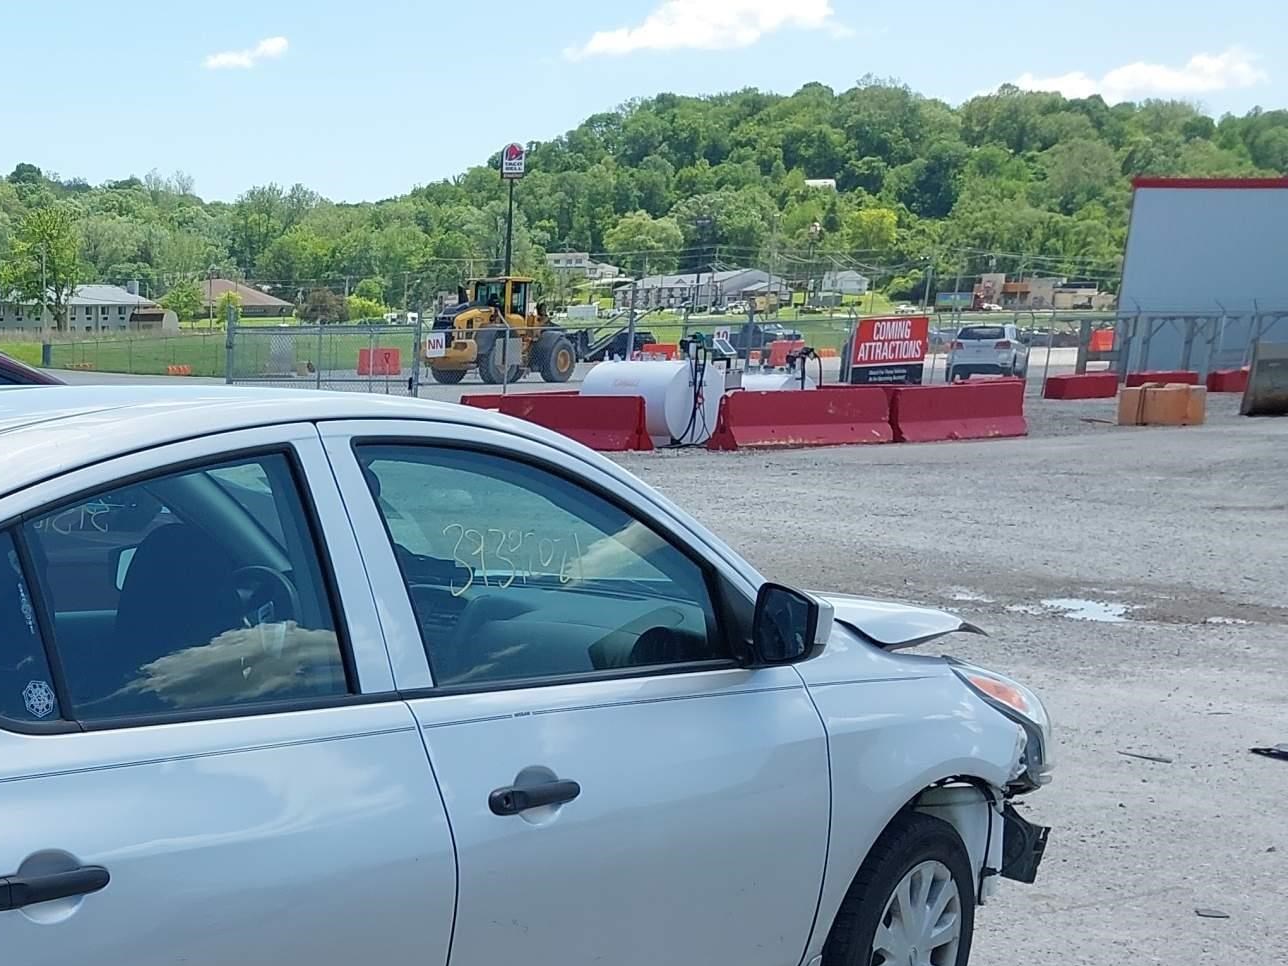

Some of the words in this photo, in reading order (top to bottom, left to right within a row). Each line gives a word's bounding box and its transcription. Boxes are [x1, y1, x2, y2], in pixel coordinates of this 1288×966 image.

[873, 320, 912, 340] COMING
[428, 338, 443, 349] NN
[857, 340, 922, 361] ATTRACTIONS
